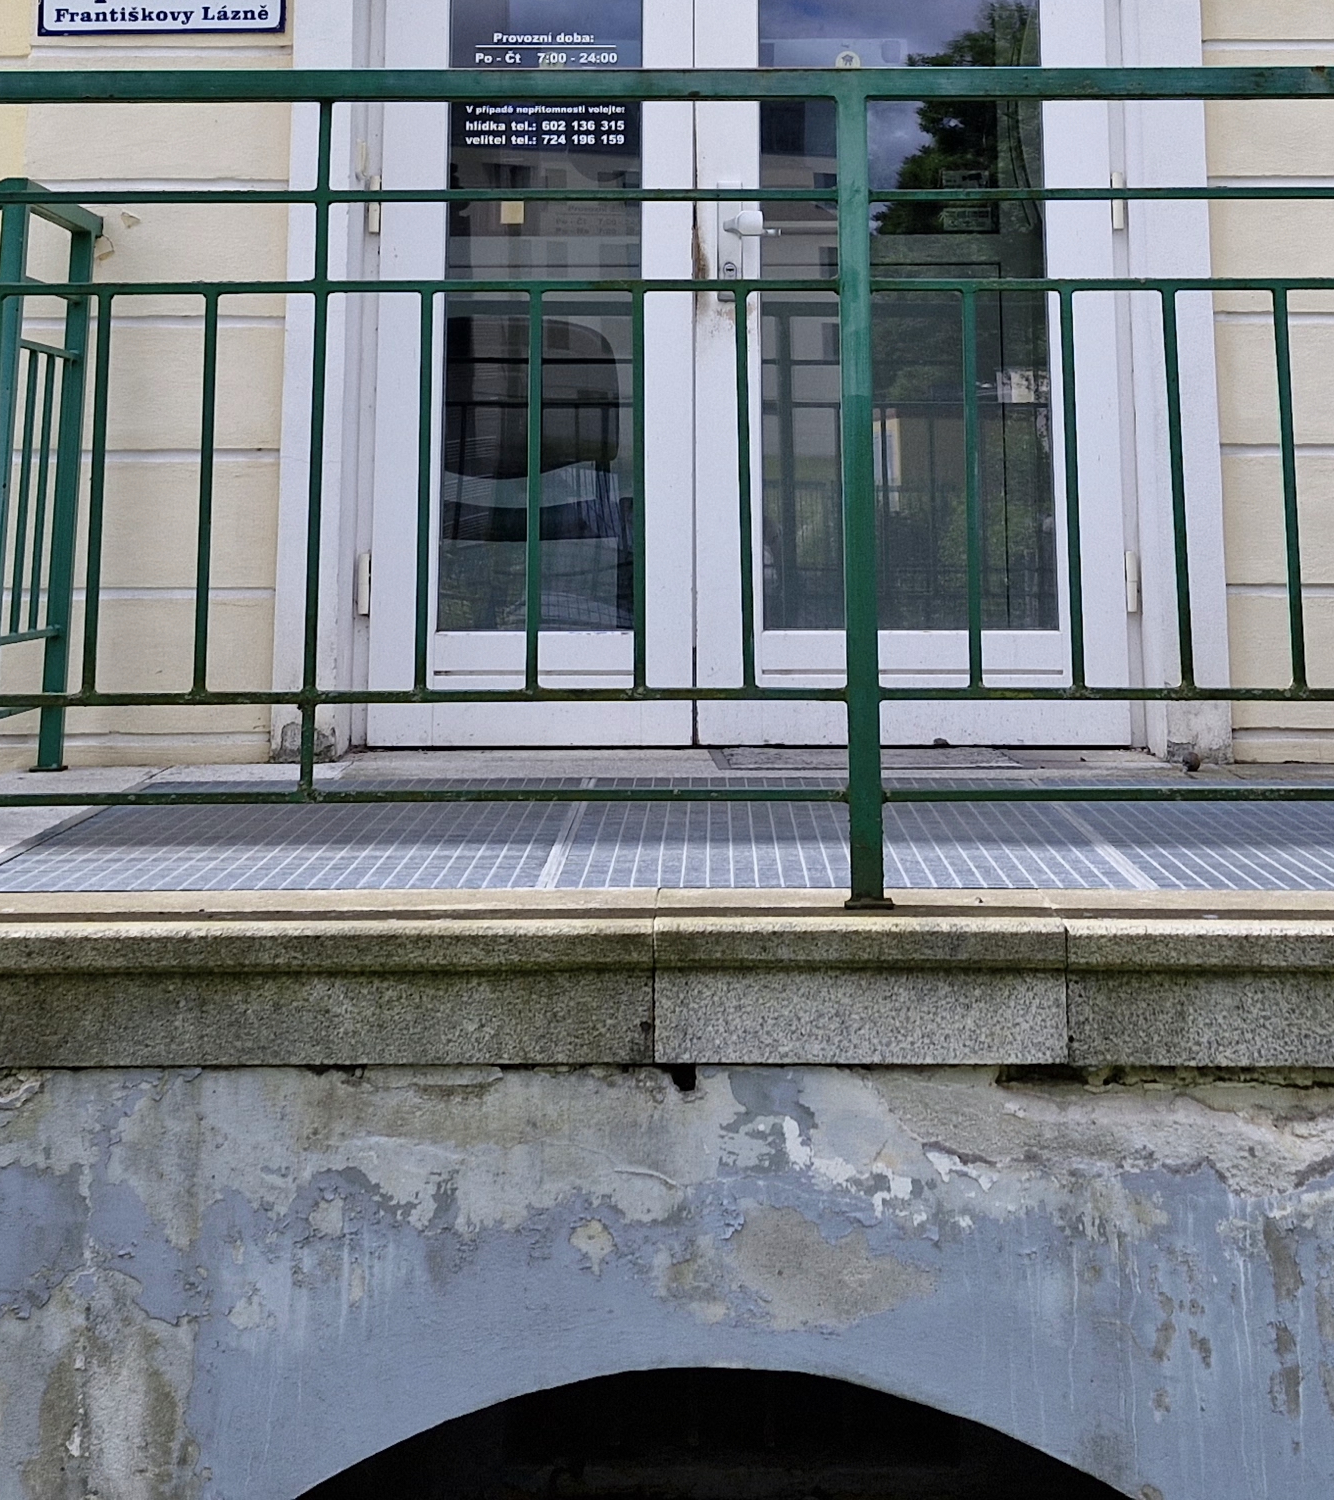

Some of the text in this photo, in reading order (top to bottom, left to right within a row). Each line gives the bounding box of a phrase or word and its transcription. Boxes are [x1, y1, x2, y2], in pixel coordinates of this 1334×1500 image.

[54, 5, 270, 25] Františkovy Lázně
[493, 32, 595, 43] Provozní doba:
[475, 53, 493, 64] Po
[504, 50, 521, 64] Čt
[537, 52, 567, 64] 7:00
[579, 52, 618, 64] 24:00
[465, 105, 474, 114] V
[588, 105, 626, 115] volejte:
[465, 120, 625, 131] hlídka tel.: 602 136 315
[465, 134, 625, 145] velitel tel.: 724 196 159
